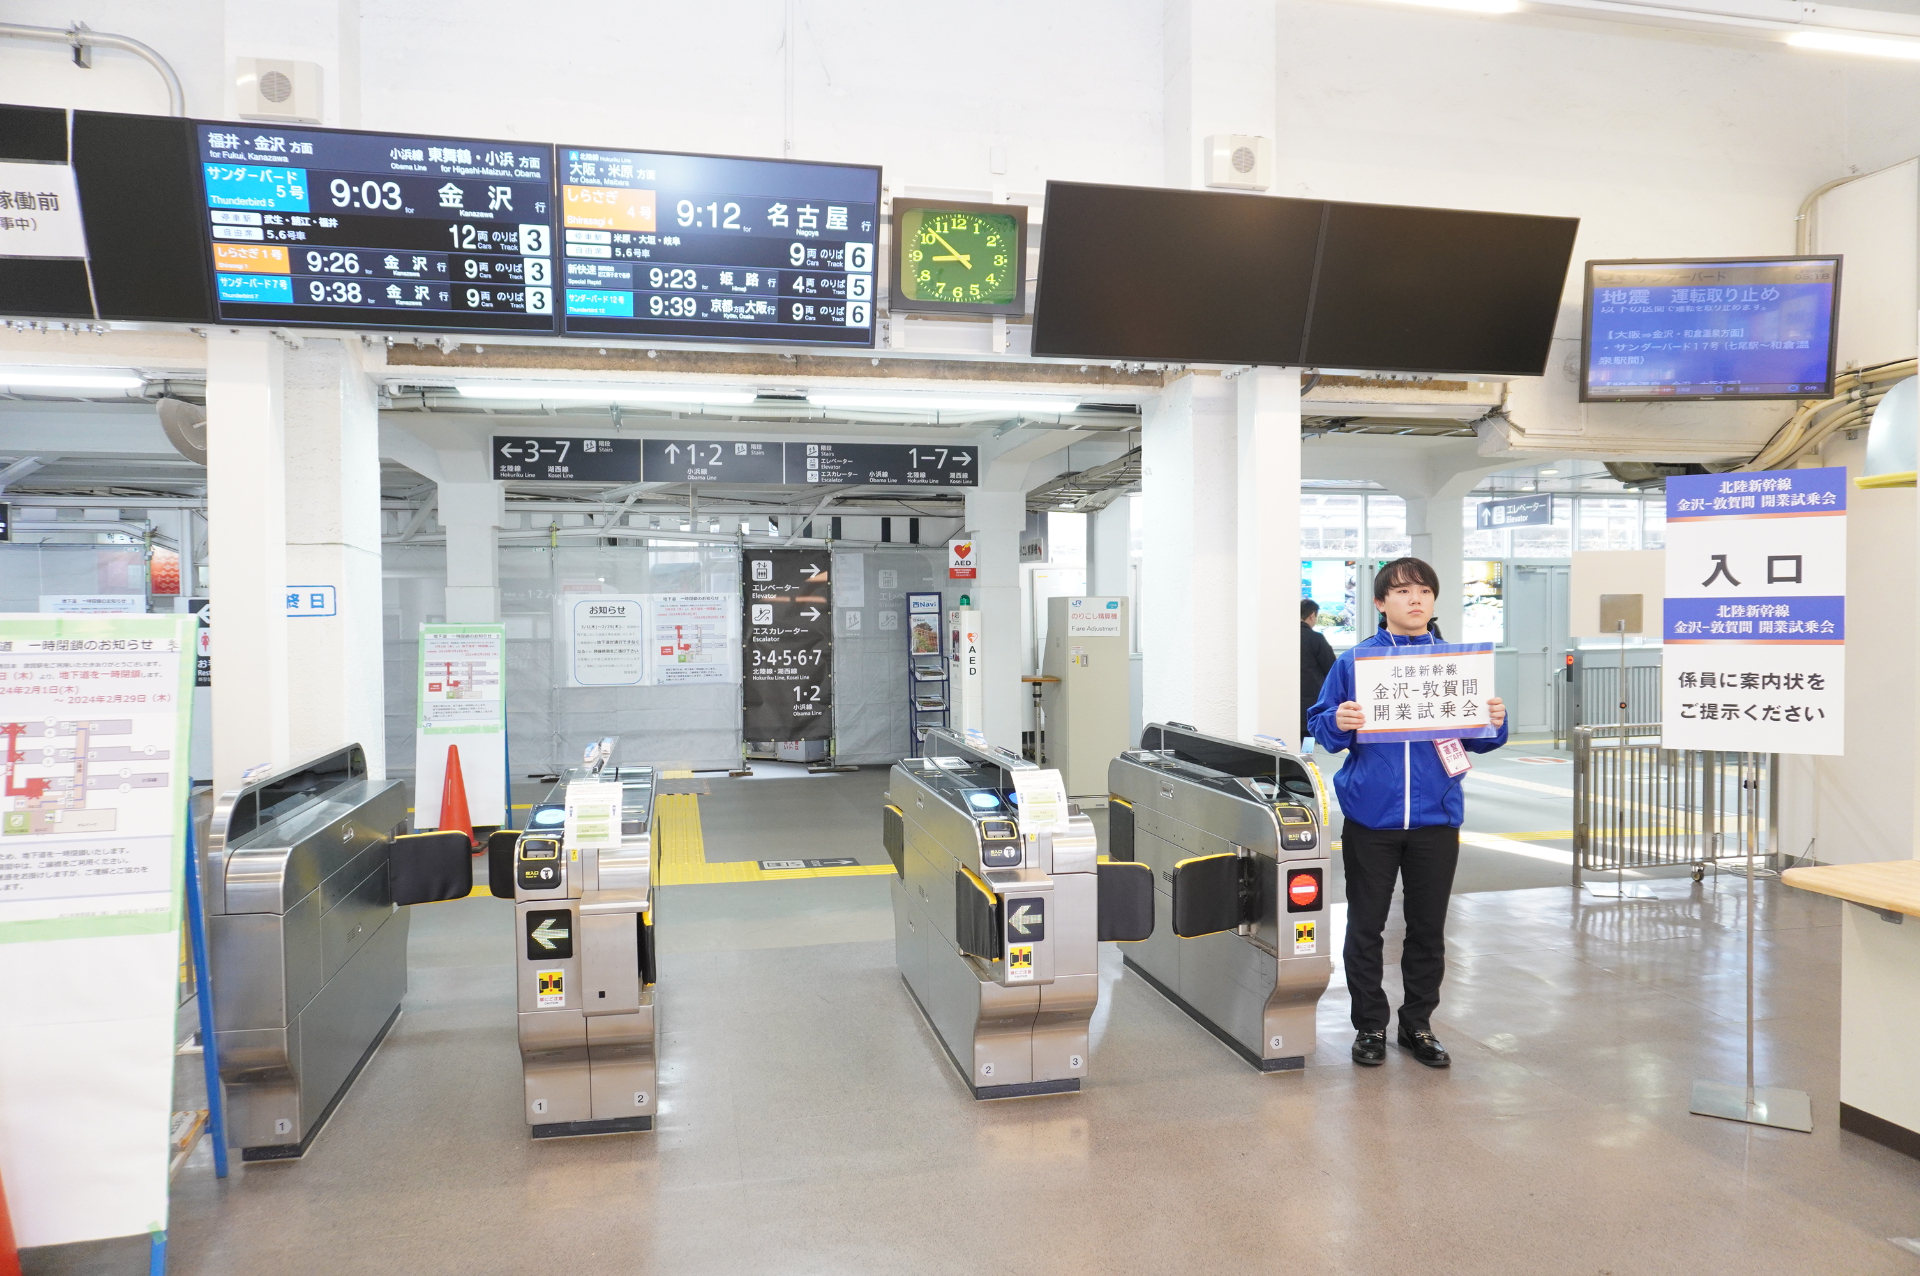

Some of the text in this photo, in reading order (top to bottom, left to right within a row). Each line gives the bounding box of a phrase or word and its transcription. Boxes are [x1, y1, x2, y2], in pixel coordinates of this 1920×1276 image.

[208, 133, 312, 154] 福井・金沢 方面
[248, 153, 288, 162] Kanazawa
[390, 147, 540, 168] 小浜線 東舞鶴・小浜 方面
[208, 168, 297, 184] サンダーバード
[570, 162, 656, 180] 大阪・米原 方面
[210, 196, 264, 207] Thunderbird
[331, 179, 545, 213] 9:03 金沢 行
[568, 188, 618, 204] しらさぎ
[460, 209, 493, 218] Kanazawa
[567, 216, 606, 226] Shirasagi
[677, 200, 871, 231] 9:12 名古屋 行
[936, 222, 980, 234] 11 1
[951, 218, 966, 229] 12
[449, 225, 541, 251] 12 両 のりば 3
[921, 233, 996, 246] 10 2
[789, 243, 865, 268] 9 のりば 6
[913, 250, 1004, 266] 9 3
[307, 252, 359, 274] 9:26
[384, 254, 427, 272] 金沢
[465, 260, 478, 278] 9
[496, 262, 522, 273] のりば
[531, 262, 544, 281] 3
[568, 264, 864, 296] 新快速 9:23 姫路 4 のりば 5
[920, 270, 996, 284] 8 4
[310, 281, 362, 303] 9:38
[386, 284, 430, 300] 金沢
[467, 288, 480, 308] 9
[497, 291, 524, 302] のりば
[533, 291, 545, 310] 3
[936, 283, 979, 298] 7 5 6
[1602, 286, 1780, 305] 地震 運転取り止め
[650, 296, 696, 318] 9:39
[793, 304, 804, 320] 9
[820, 305, 845, 316] のりば
[852, 305, 864, 323] 6
[1719, 478, 1792, 494] 北陸新幹線
[1507, 502, 1546, 514] エレベーター
[1677, 492, 1836, 511] 金沢-敦賀間 開業試乗会
[1507, 515, 1528, 523] Elevator
[1702, 554, 1802, 588] 入口
[589, 606, 625, 615] お知らせ
[1717, 604, 1790, 618] 北陸新幹線
[1675, 620, 1835, 634] 金沢-敦賀間 開業試乗会
[29, 640, 153, 651] 一時閉鎖のお知らせ
[1392, 664, 1458, 678] 北陸新幹線
[1679, 671, 1825, 690] 係員に案内状を
[1373, 679, 1478, 700] 金沢-敦賀間
[1374, 700, 1479, 721] 開業試乗会
[1680, 703, 1825, 722] ご提示ください
[1446, 751, 1463, 763] STAFF
[1274, 1038, 1280, 1046] 3
[985, 1057, 1079, 1075] 2 3
[538, 1094, 644, 1111] 1 2
[279, 1121, 284, 1130] 1
